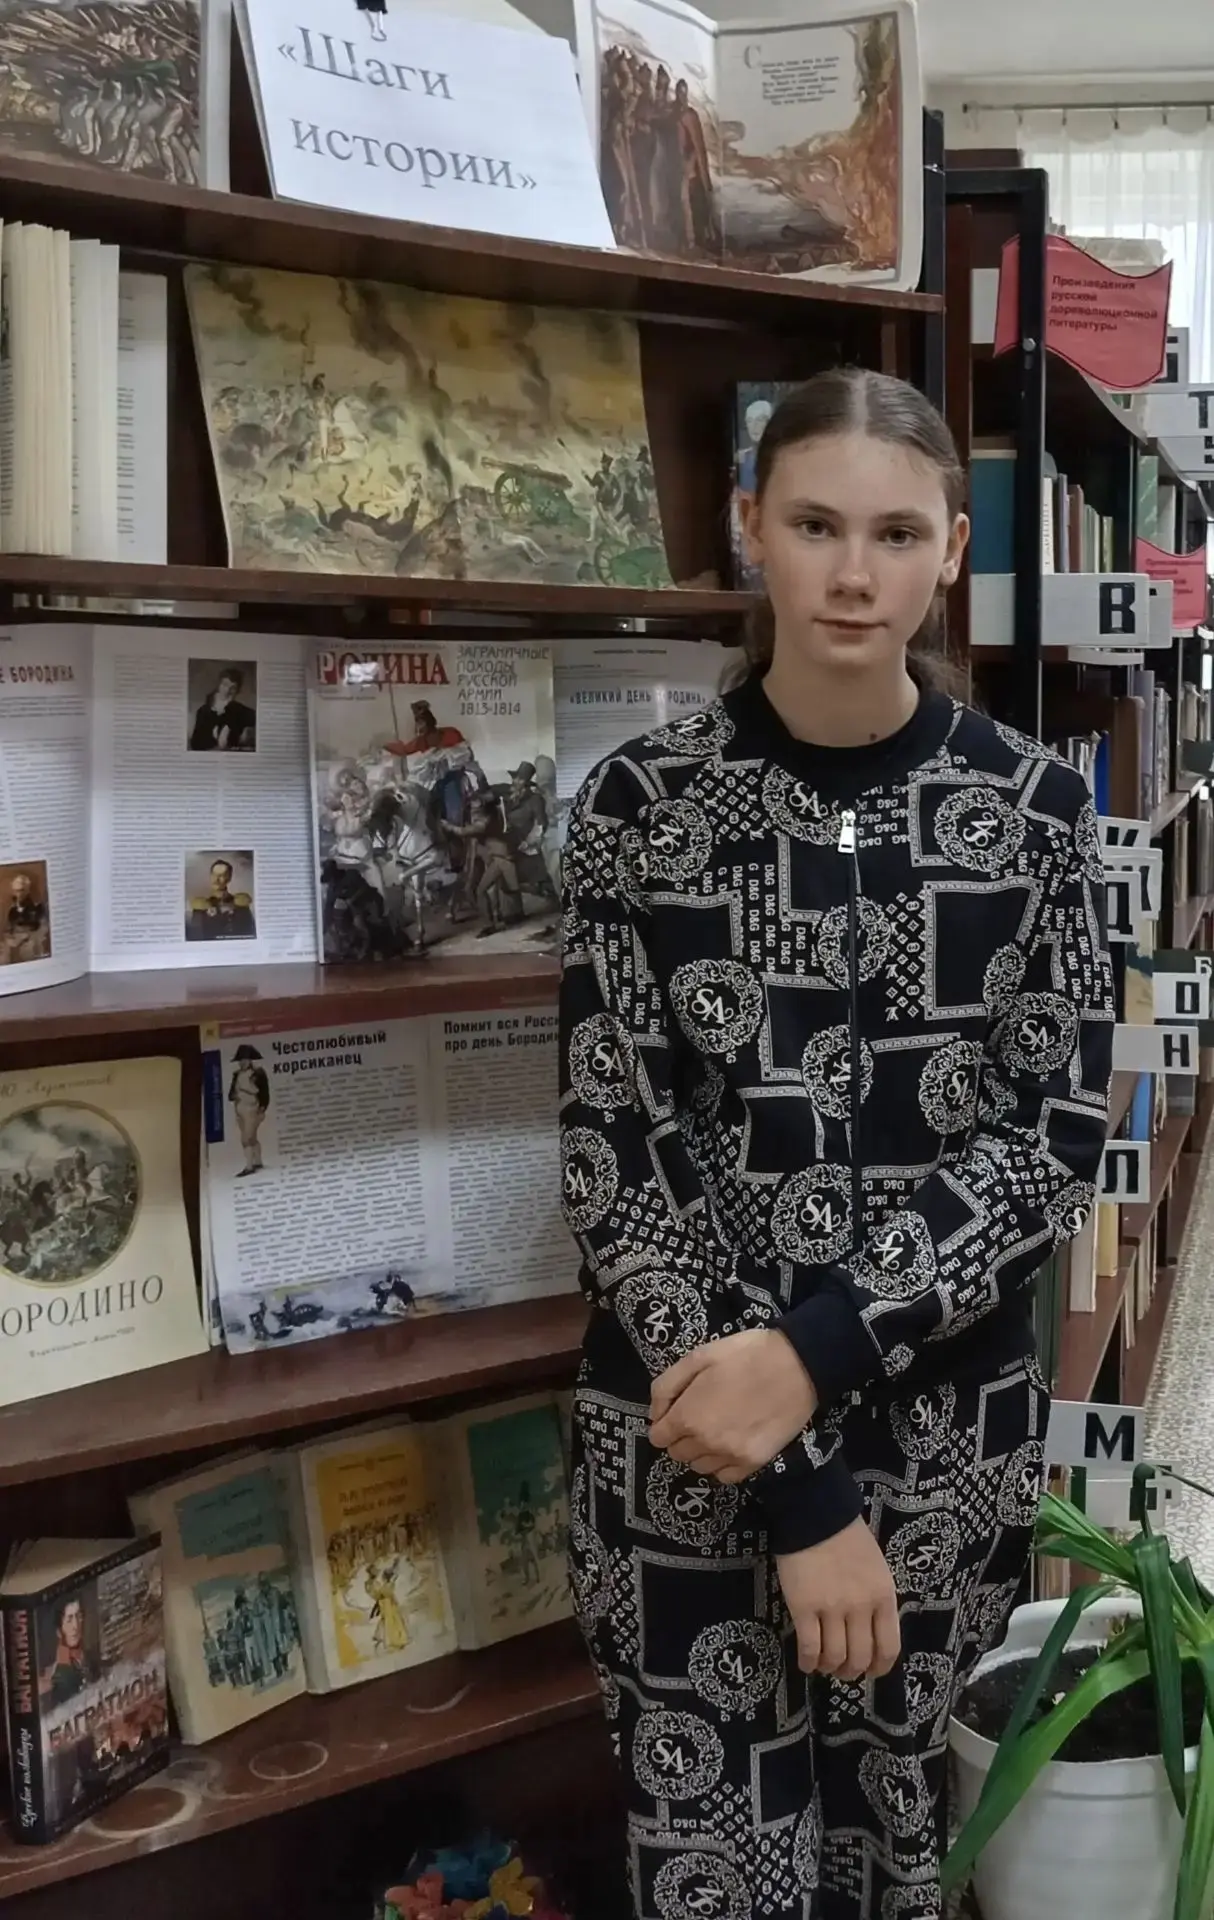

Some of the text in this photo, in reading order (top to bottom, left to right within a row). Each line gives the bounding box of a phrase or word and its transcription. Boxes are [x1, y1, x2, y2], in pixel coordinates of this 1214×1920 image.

[277, 25, 455, 100] «Шаги
[290, 117, 537, 189] истории»
[1052, 274, 1135, 290] Произведения
[1051, 291, 1097, 302] русской
[1048, 318, 1118, 332] литературы
[460, 701, 521, 716] 1813-1814
[444, 1020, 492, 1035] Помнит
[497, 1018, 519, 1030] вся
[272, 1030, 387, 1056] Честолюбивый
[445, 1039, 467, 1053] про
[472, 1036, 503, 1050] день
[273, 1053, 363, 1075] корсиканец
[0, 1274, 164, 1338] ОРОДИНО
[49, 1667, 158, 1749] БАГРАТИОН
